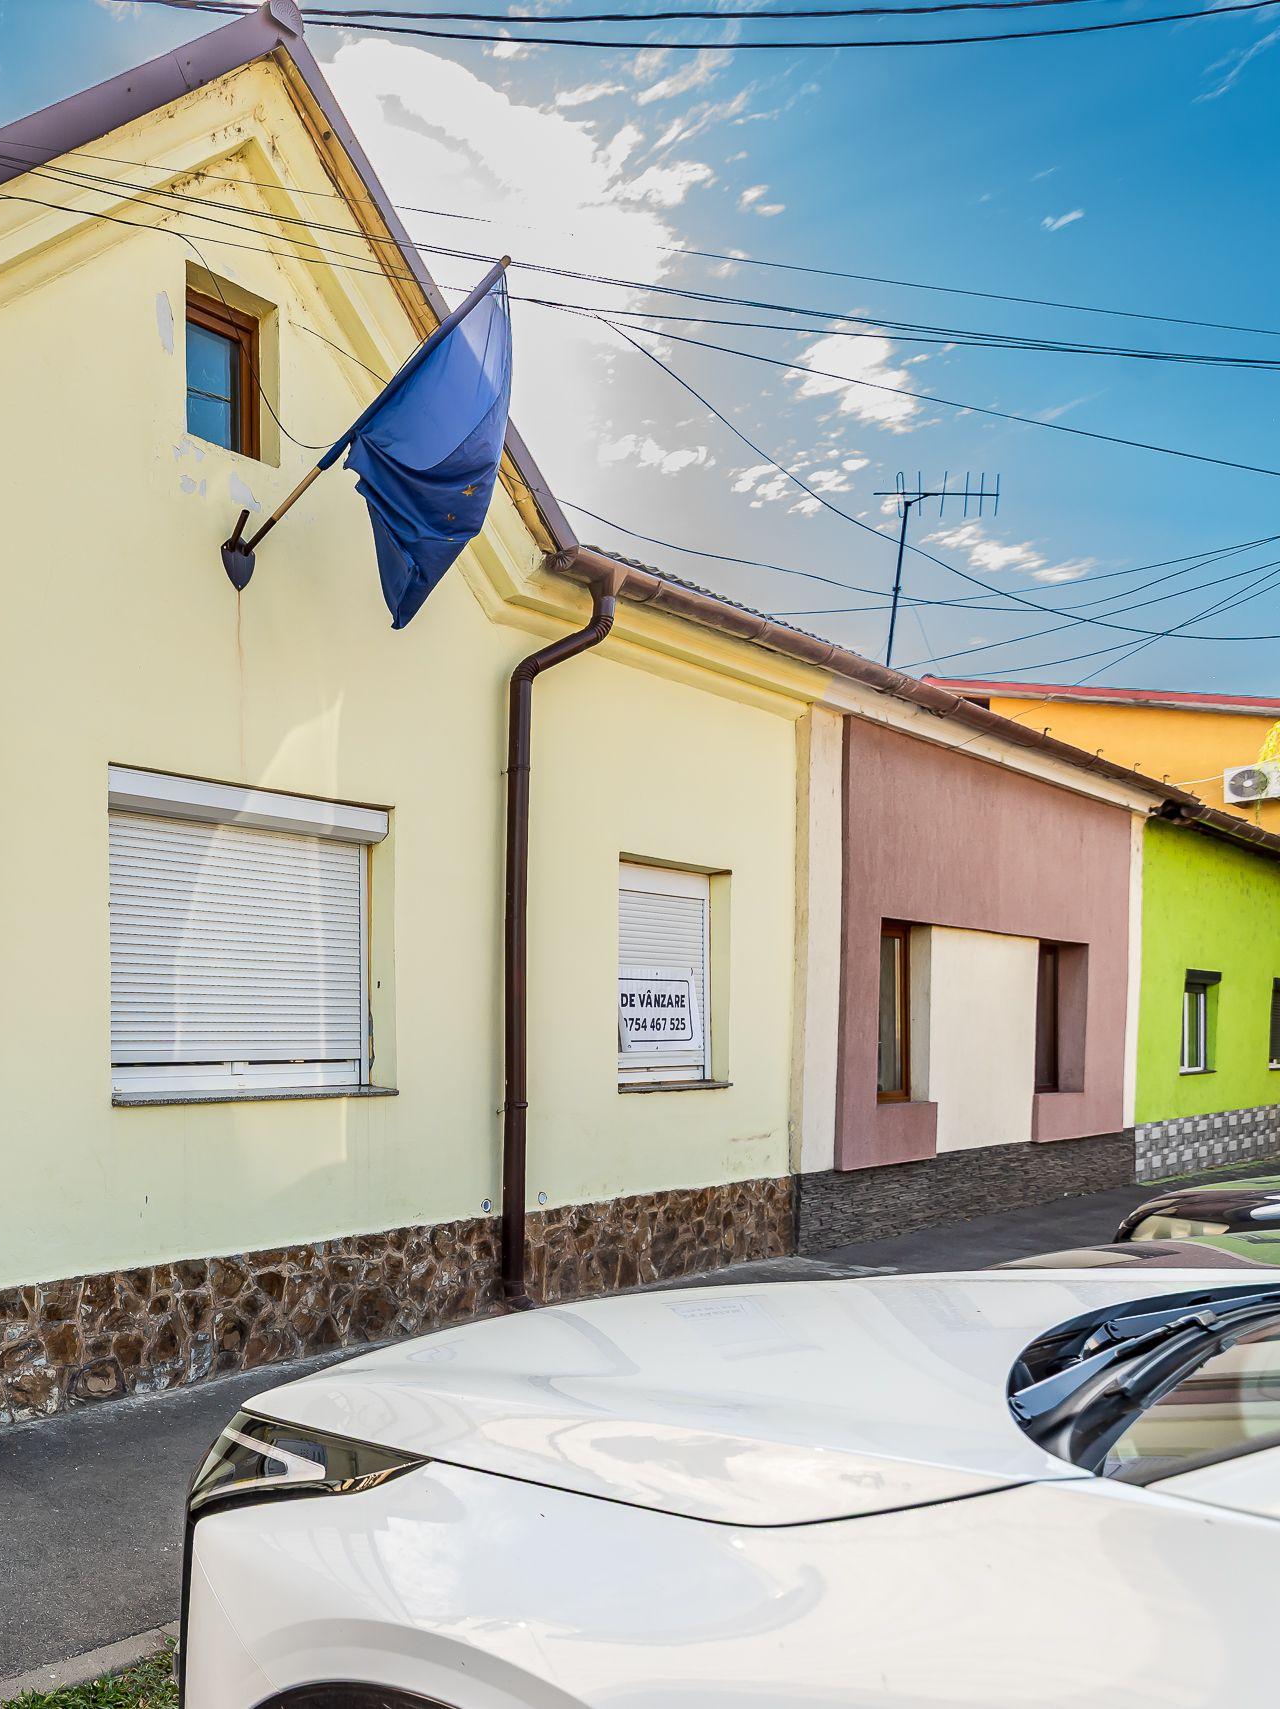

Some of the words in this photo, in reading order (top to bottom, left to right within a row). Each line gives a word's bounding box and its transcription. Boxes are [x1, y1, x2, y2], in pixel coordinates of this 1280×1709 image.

[620, 993, 636, 1008] DE
[638, 989, 686, 1008] VÂNZARE
[650, 1017, 667, 1031] 467
[669, 1017, 686, 1031] 525
